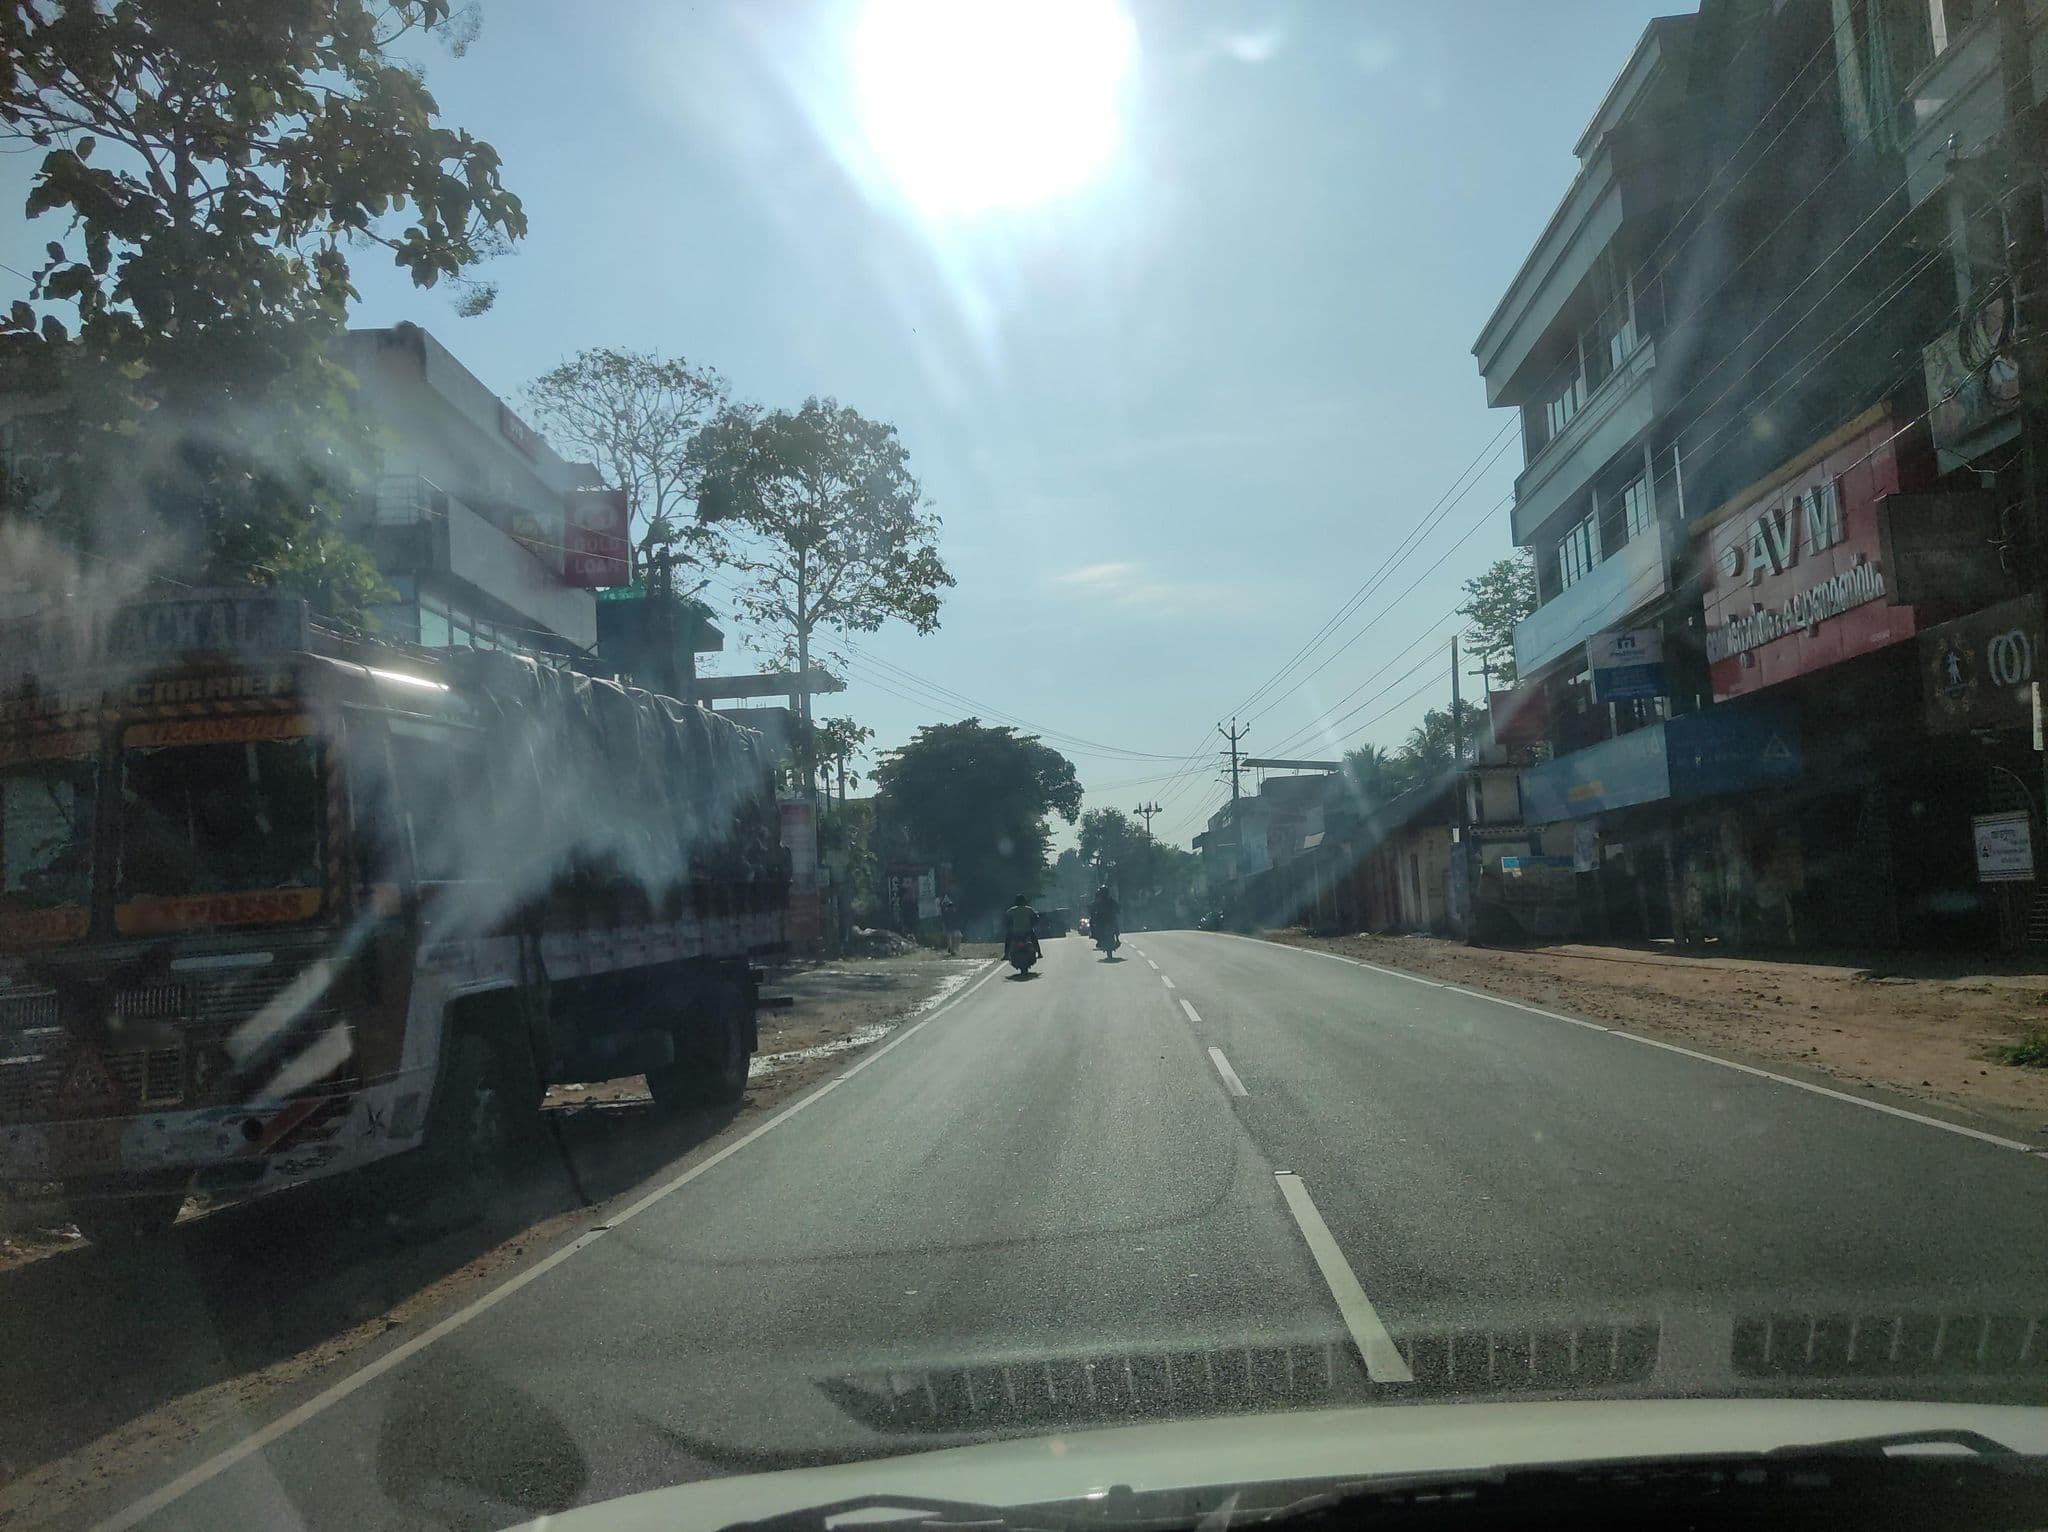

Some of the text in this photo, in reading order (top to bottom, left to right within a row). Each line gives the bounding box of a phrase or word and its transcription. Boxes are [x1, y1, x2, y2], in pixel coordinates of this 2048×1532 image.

[1746, 474, 1844, 582] AVM
[574, 536, 621, 553] GOLD
[574, 558, 620, 575] LOAN
[129, 672, 294, 704] CARRIER
